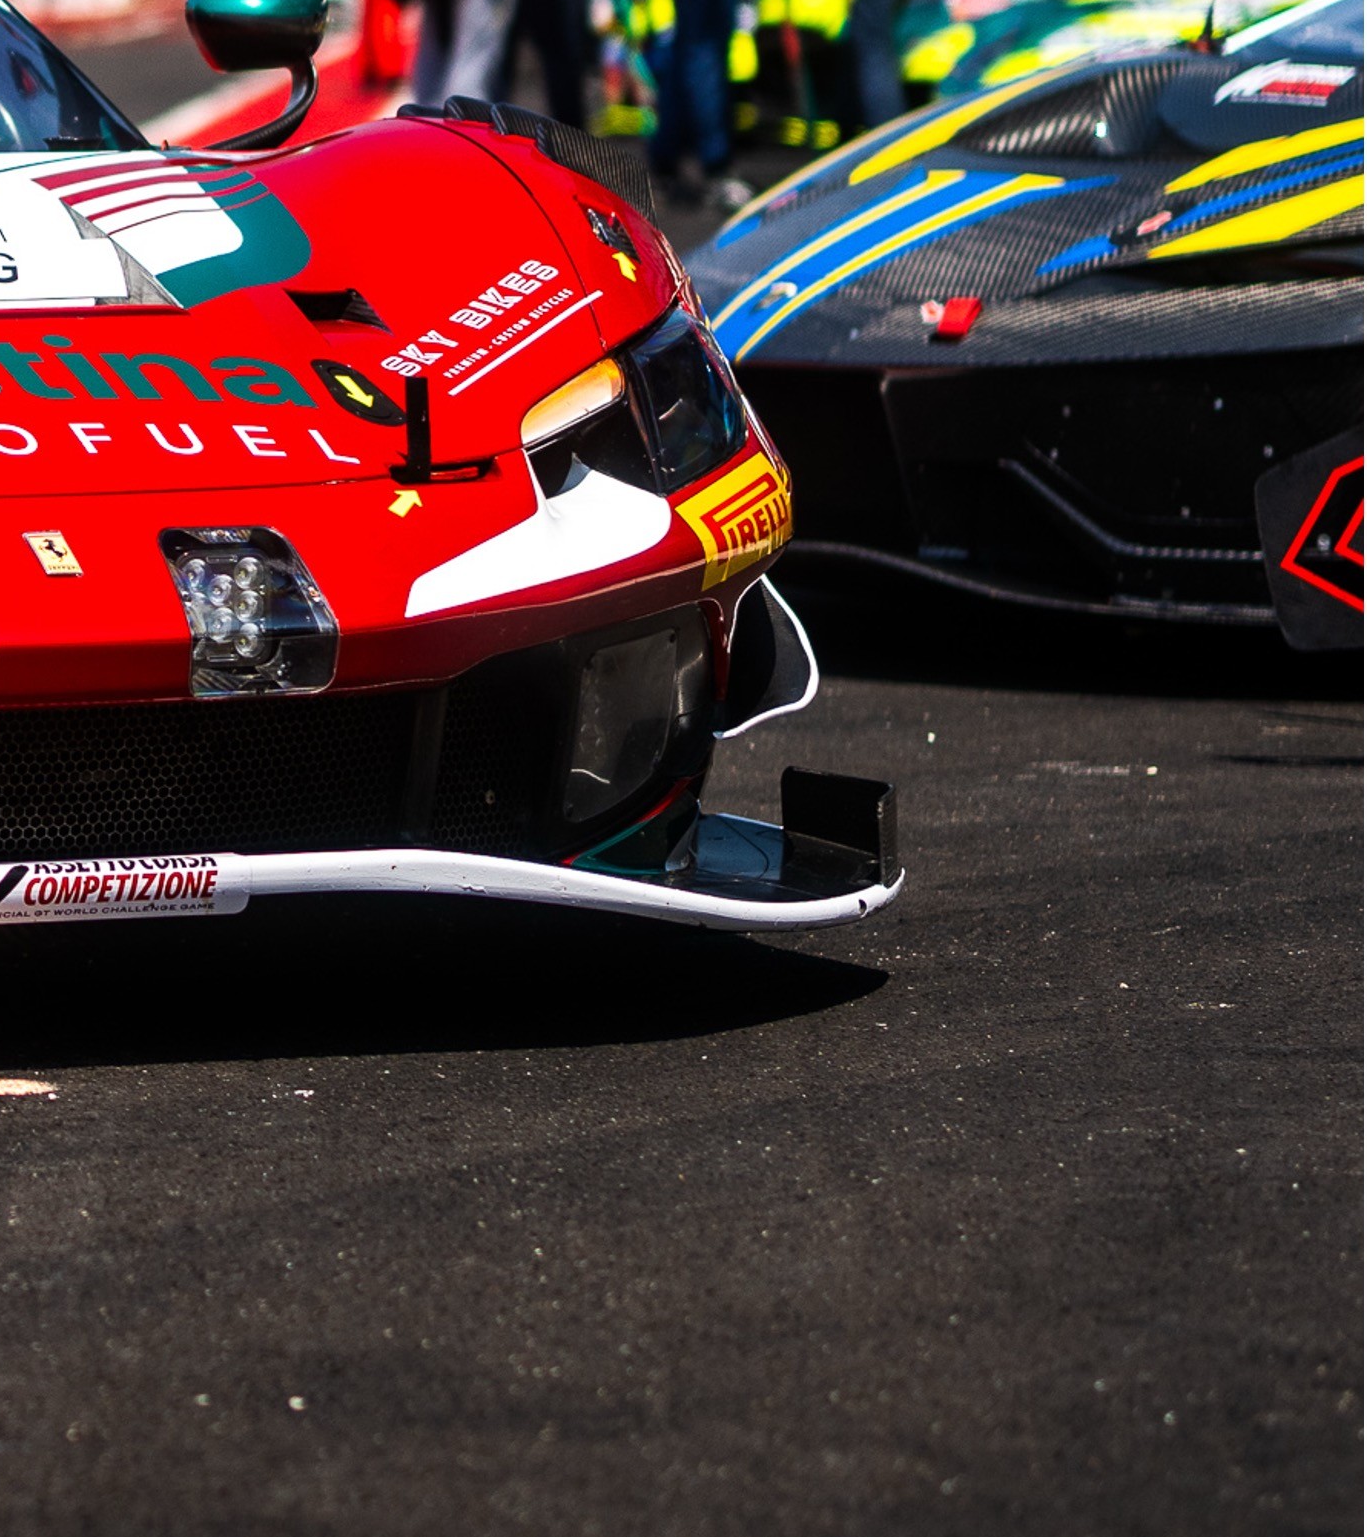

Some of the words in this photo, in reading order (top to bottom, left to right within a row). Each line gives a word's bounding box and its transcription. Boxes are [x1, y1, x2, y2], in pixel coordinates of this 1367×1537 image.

[380, 329, 459, 377] SKY
[449, 259, 560, 330] BIKES
[699, 471, 790, 568] PIRELLI
[24, 870, 218, 906] COMPETIZIONE
[54, 907, 98, 917] WORLD
[101, 904, 176, 915] CHALLENGE
[179, 902, 216, 911] GAME
